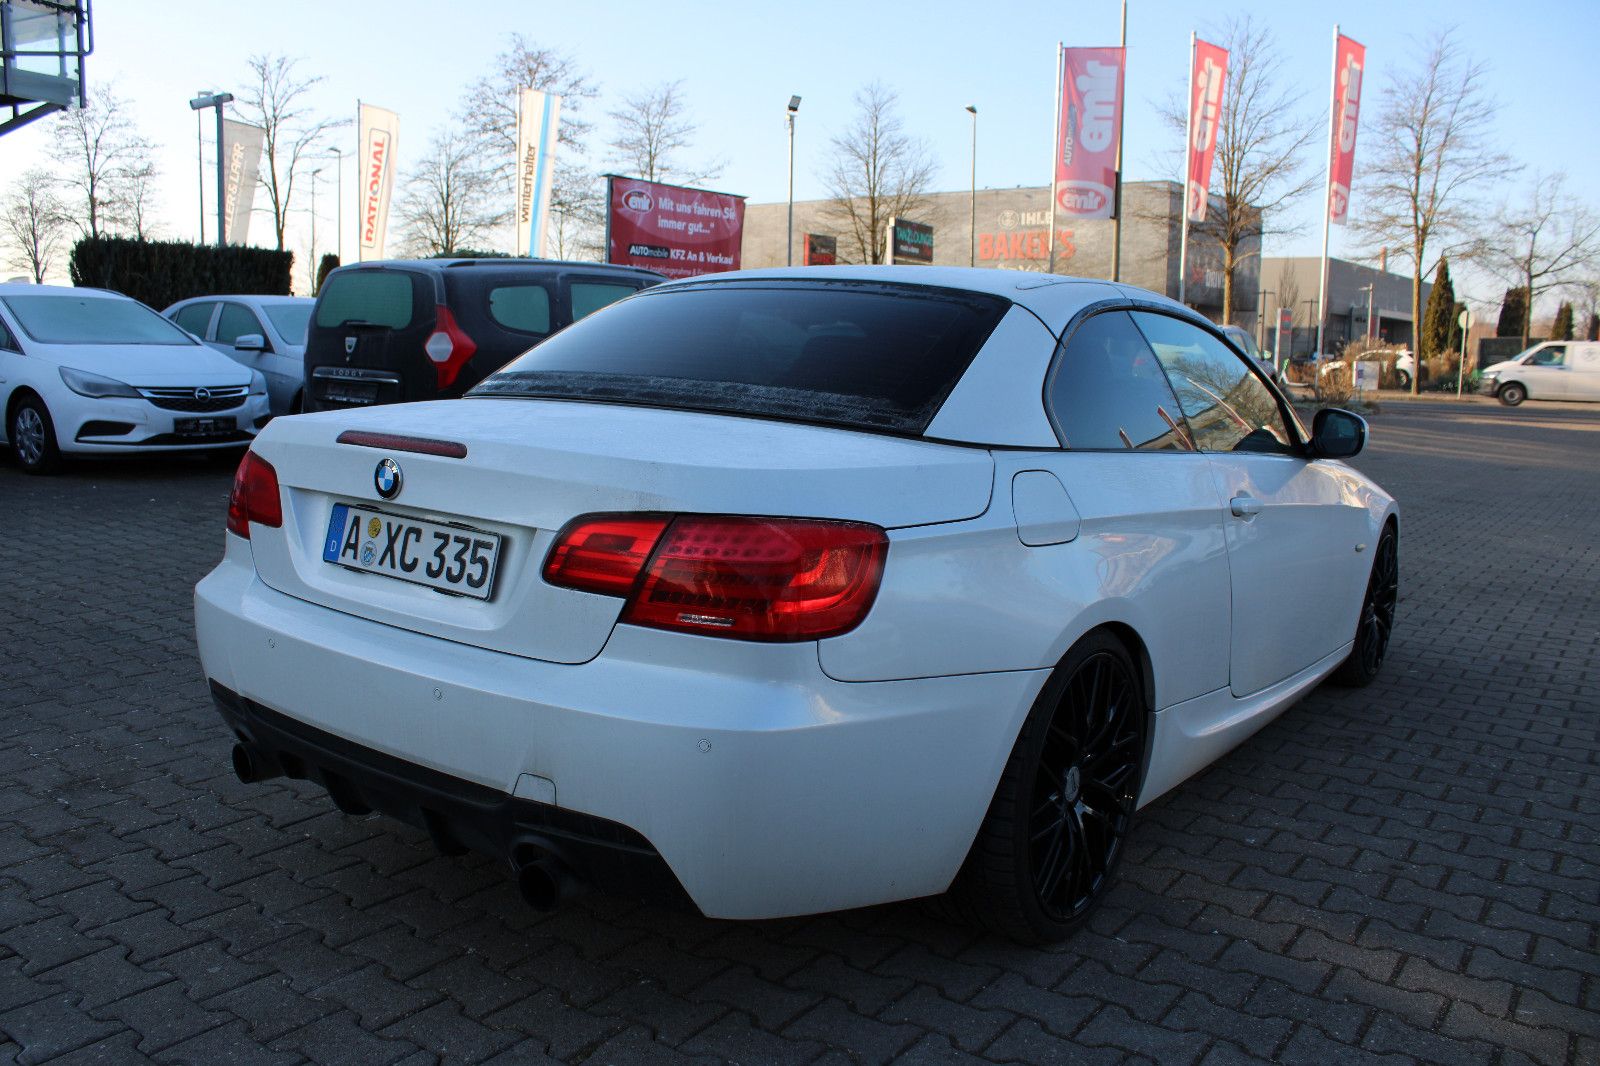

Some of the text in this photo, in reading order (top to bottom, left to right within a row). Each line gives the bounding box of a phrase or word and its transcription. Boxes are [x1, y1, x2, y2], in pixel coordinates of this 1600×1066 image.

[1076, 60, 1118, 153] emir
[1193, 57, 1223, 153] emir
[229, 142, 245, 183] LAAR
[365, 136, 385, 242] RATIONAL
[521, 143, 536, 223] winterhalter
[628, 194, 650, 210] emir
[658, 197, 736, 221] Mit uns fahren Sie
[1063, 191, 1102, 209] emir
[658, 215, 686, 231] immer
[670, 248, 686, 260] KFZ
[687, 250, 698, 262] An
[698, 251, 705, 263] &
[330, 540, 337, 553] D
[341, 515, 493, 588] A XC 335
